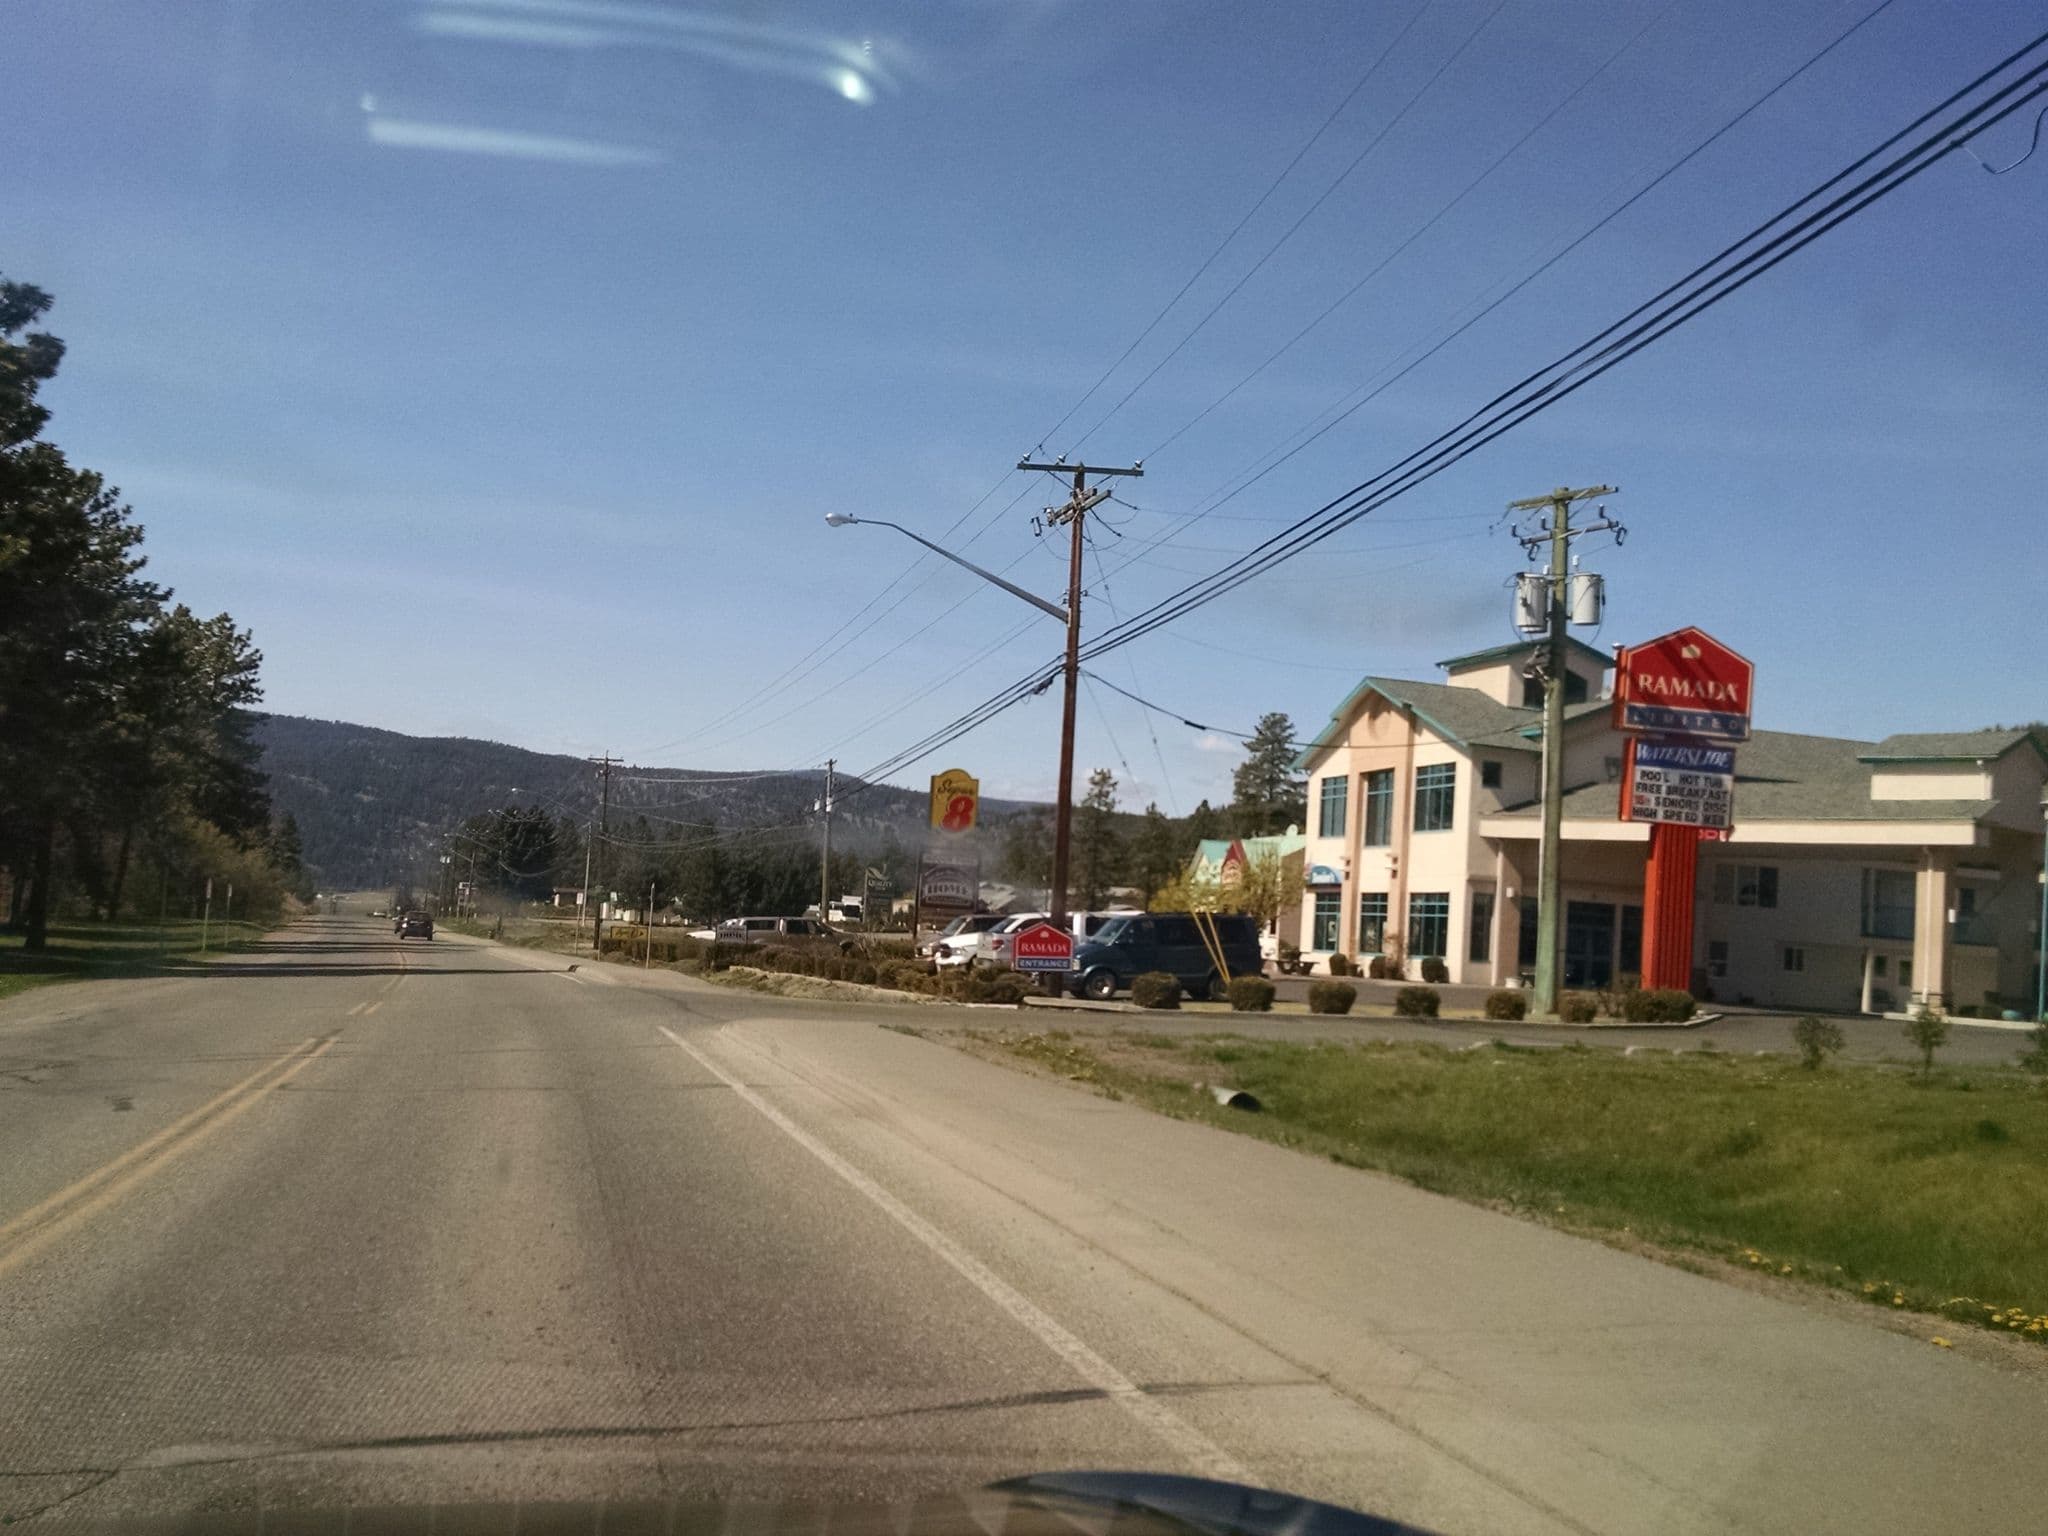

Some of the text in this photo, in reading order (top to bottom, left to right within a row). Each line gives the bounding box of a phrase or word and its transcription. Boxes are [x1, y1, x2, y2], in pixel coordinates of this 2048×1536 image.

[1638, 673, 1738, 702] RAMADA
[1634, 713, 1737, 730] LIMITED
[1636, 743, 1730, 768] WATERSLIDE
[1640, 770, 1722, 788] POOL HOT TUB
[1636, 781, 1727, 800] FREE BREAKFAST
[1654, 796, 1699, 809] SENIORS
[941, 793, 974, 832] 8
[1632, 806, 1657, 818] HIGH
[1662, 808, 1697, 821] SPEED
[1020, 942, 1069, 953] RAMADA
[1019, 959, 1069, 967] ENTRANCE
